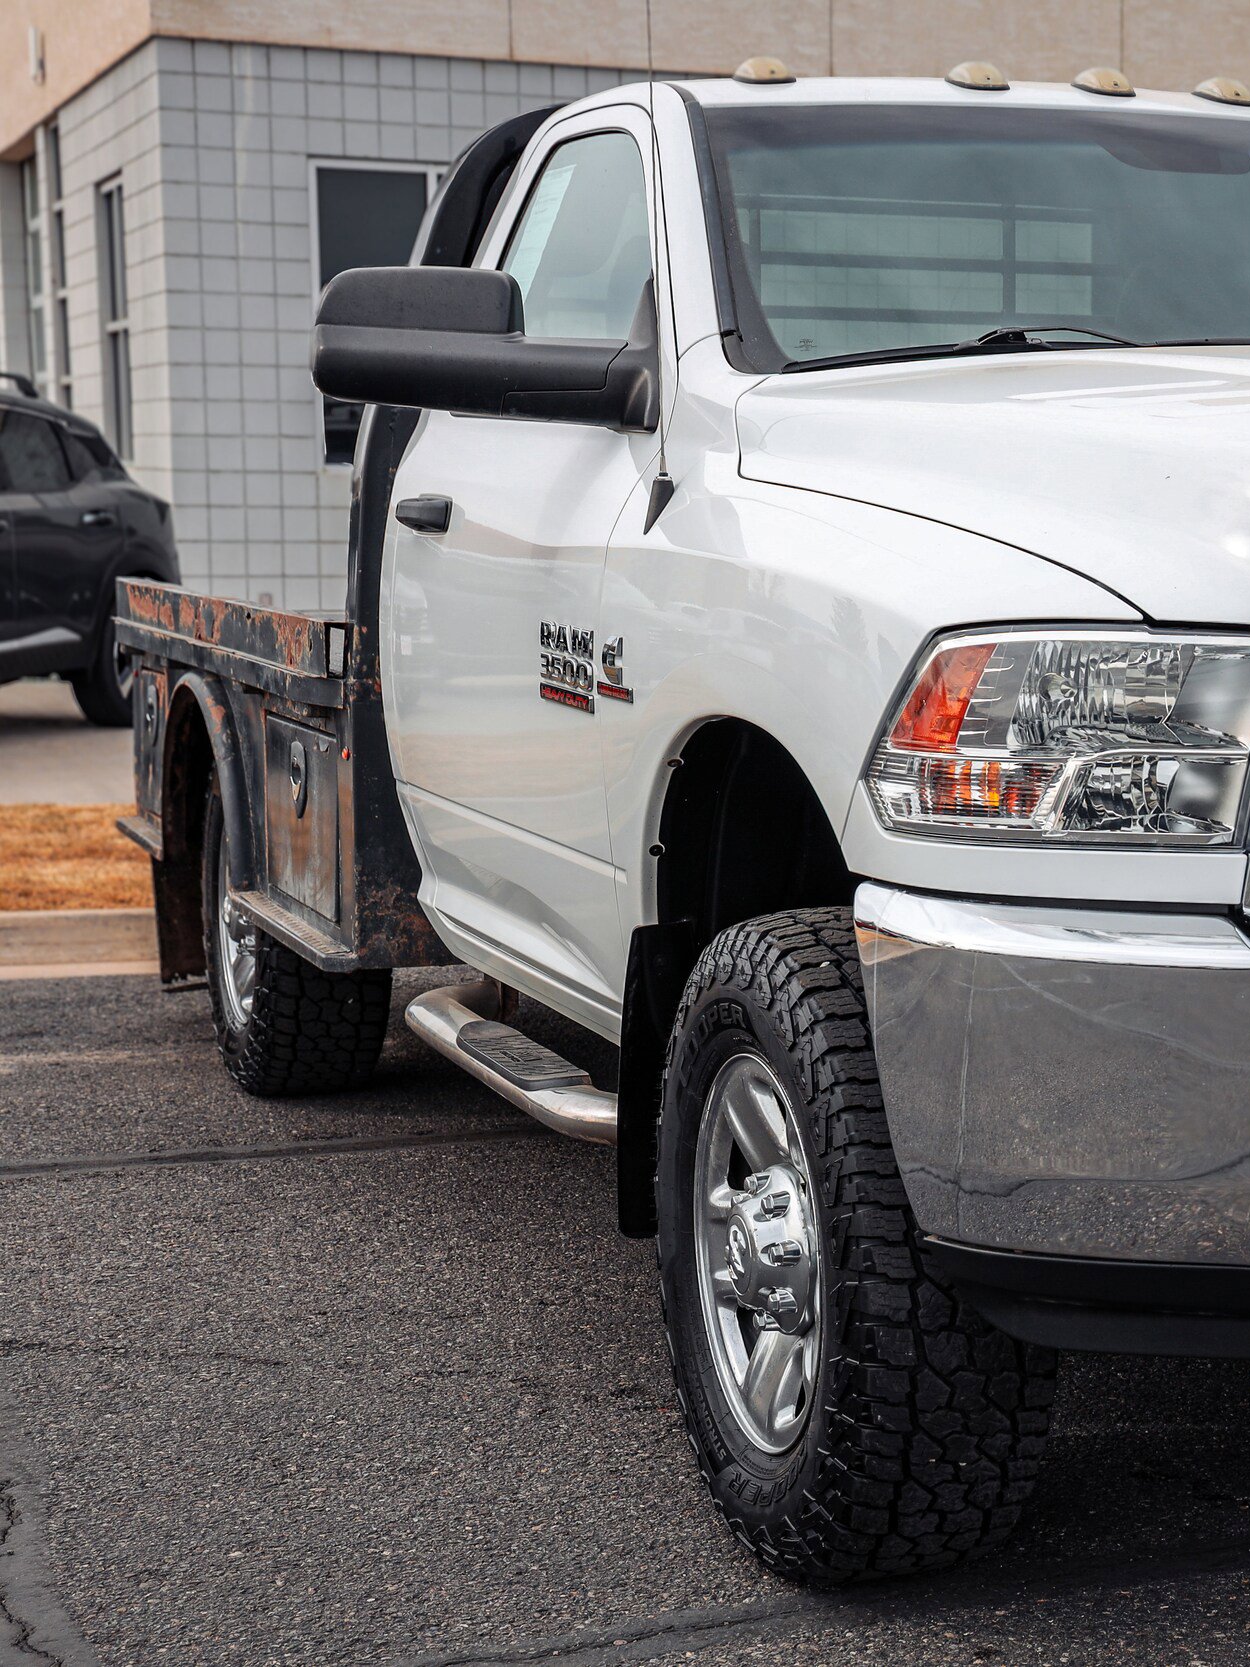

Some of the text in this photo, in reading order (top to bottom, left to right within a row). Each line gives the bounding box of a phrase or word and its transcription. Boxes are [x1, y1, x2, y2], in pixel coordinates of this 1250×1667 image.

[540, 620, 594, 660] RAM
[540, 652, 594, 692] 3500
[680, 1003, 747, 1088] COOPER
